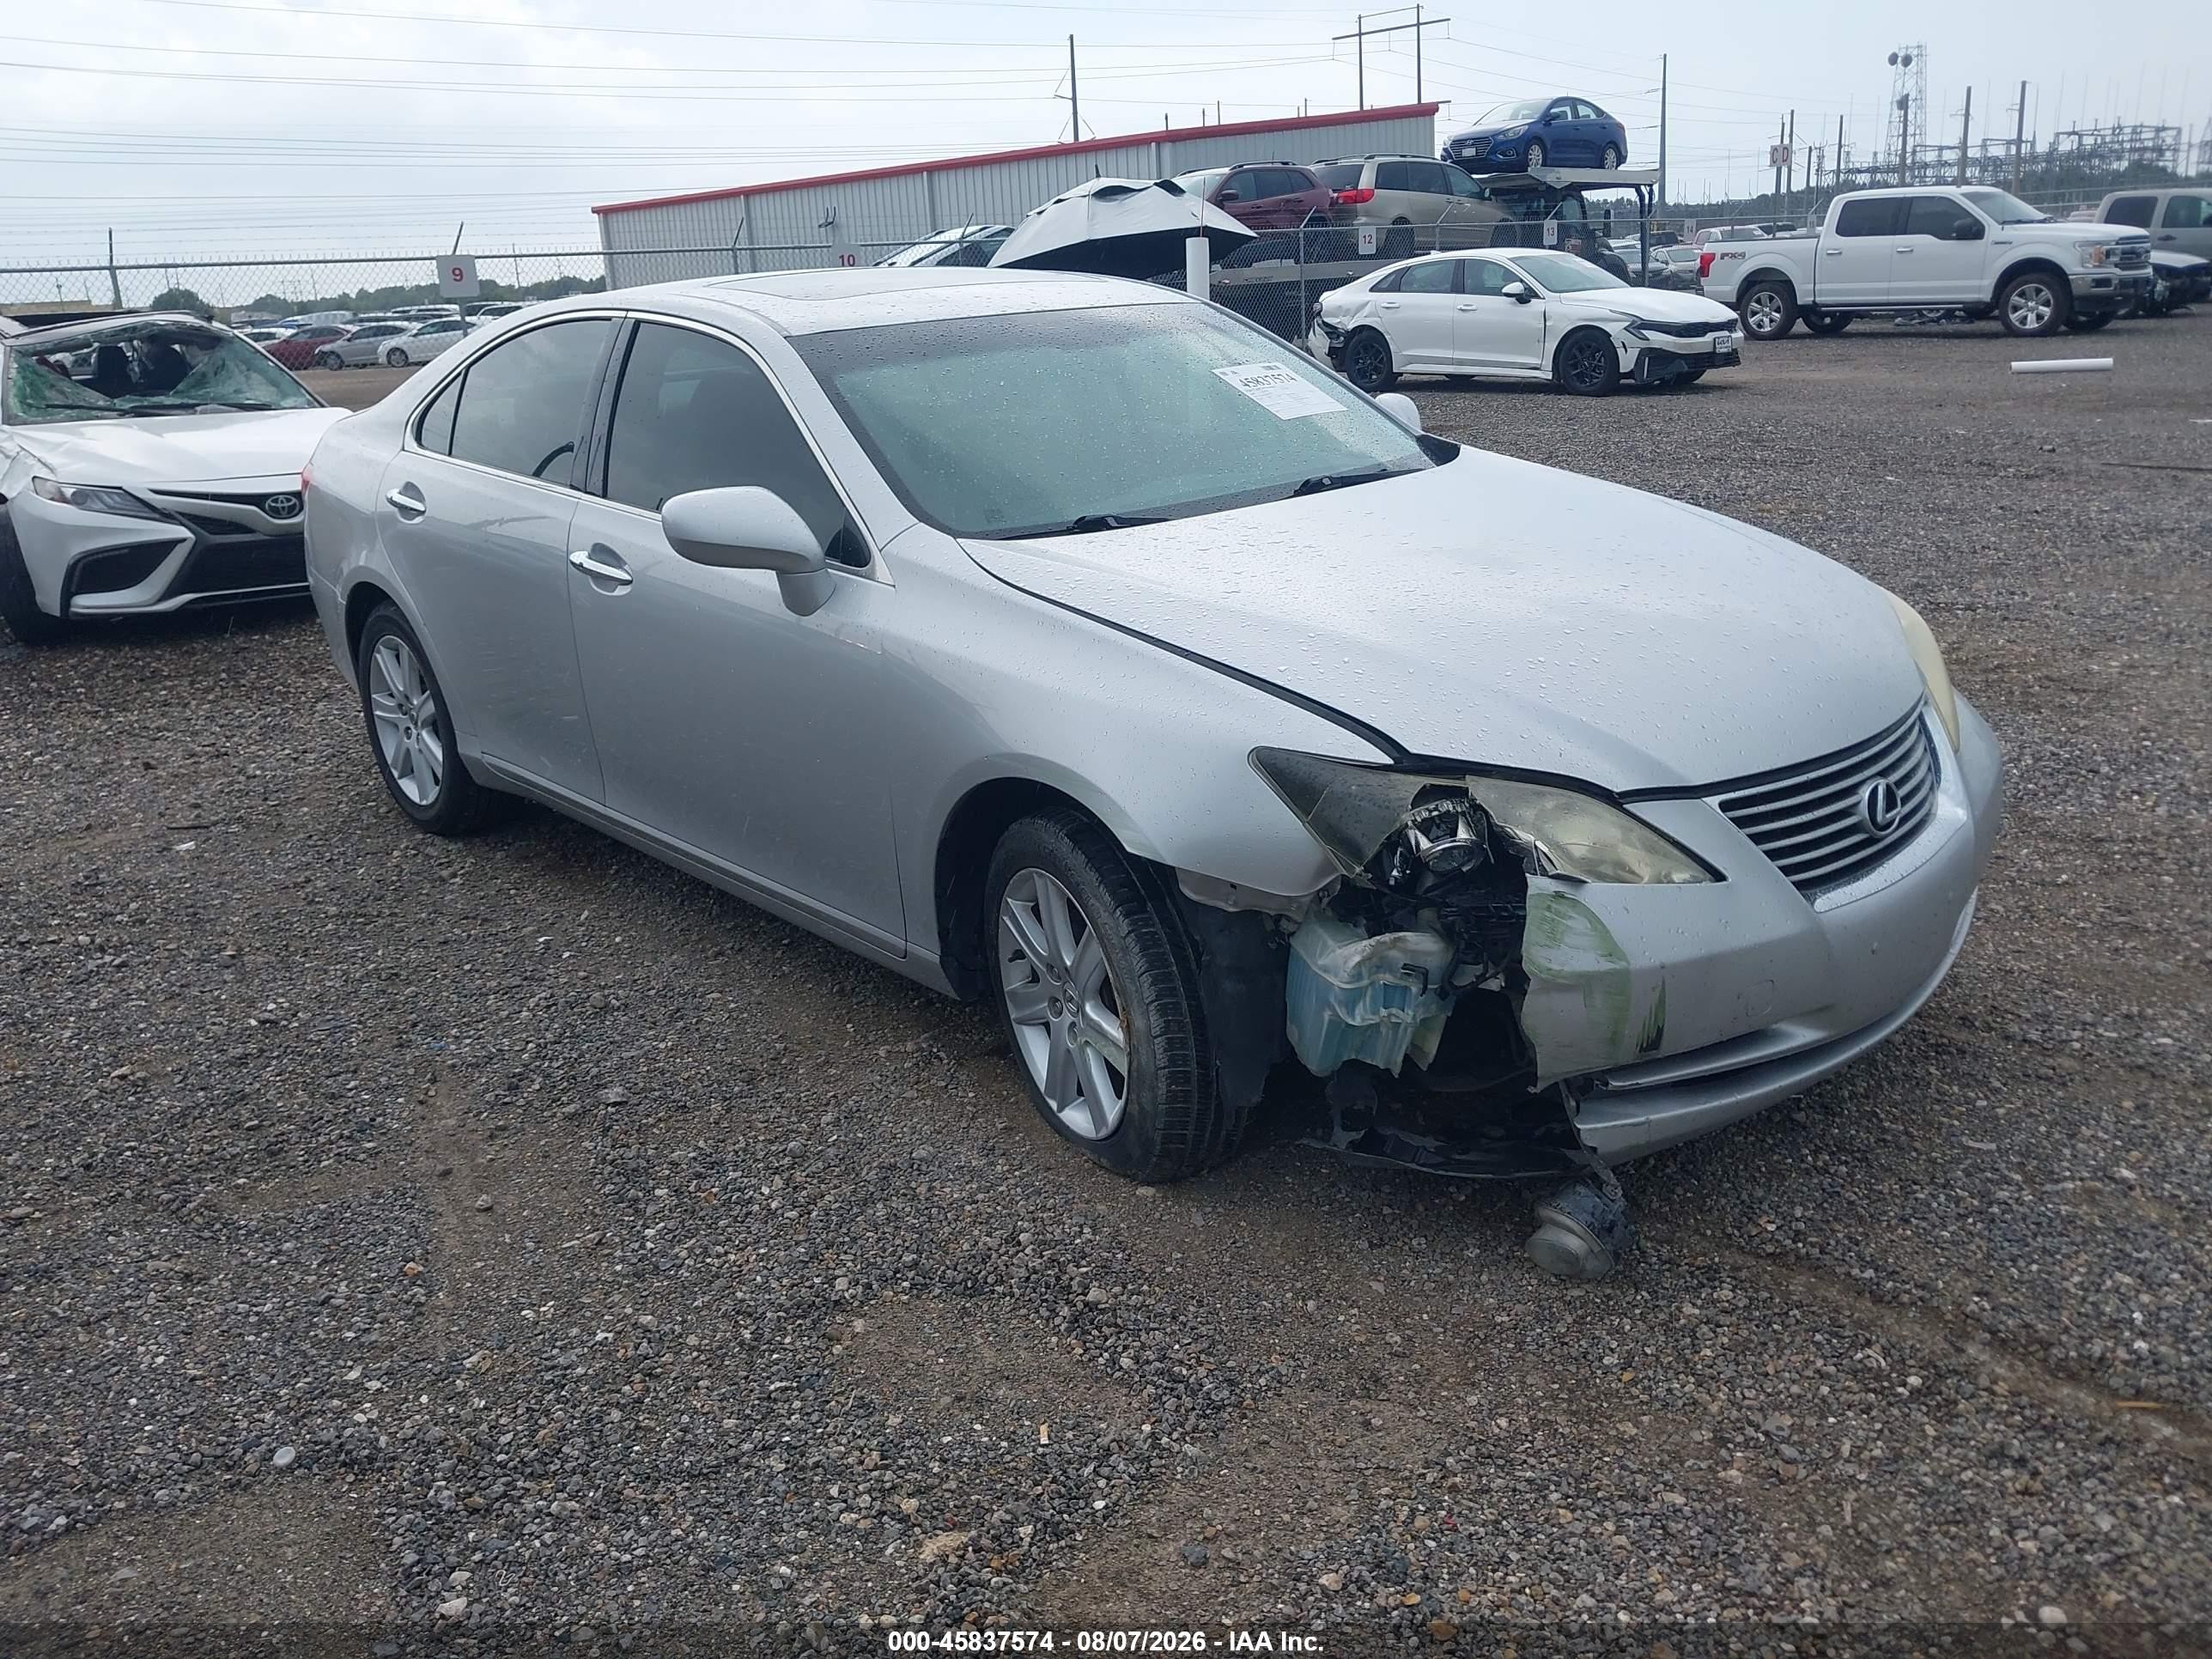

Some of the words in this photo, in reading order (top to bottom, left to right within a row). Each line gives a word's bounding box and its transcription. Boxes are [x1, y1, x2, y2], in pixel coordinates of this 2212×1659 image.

[1771, 147, 1778, 164] C
[1782, 147, 1789, 163] D
[1362, 234, 1373, 245] 12
[1547, 227, 1555, 237] 13
[838, 253, 856, 267] 10
[452, 267, 464, 283] 9
[1238, 373, 1298, 389] 45837574
